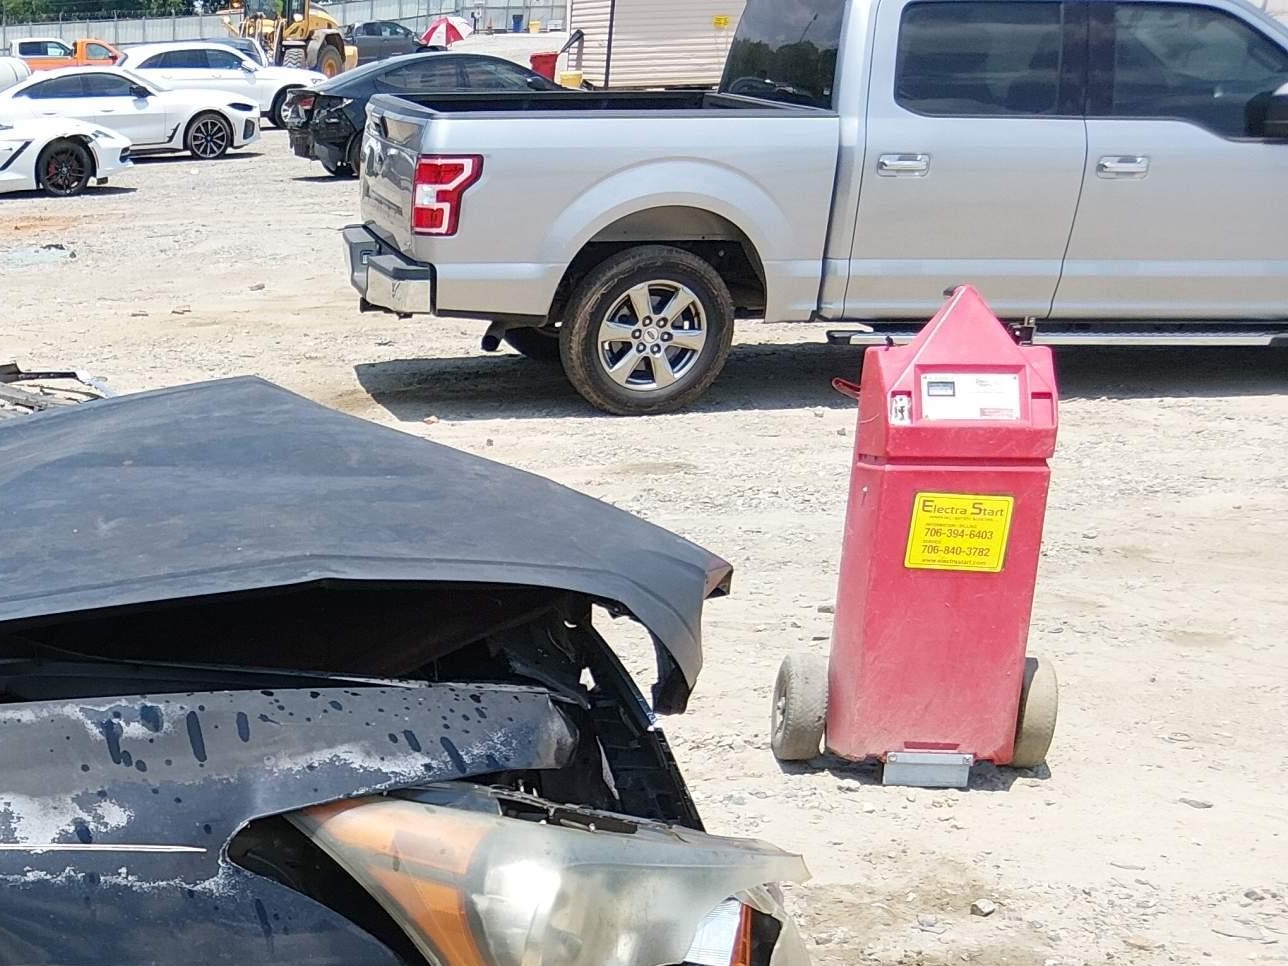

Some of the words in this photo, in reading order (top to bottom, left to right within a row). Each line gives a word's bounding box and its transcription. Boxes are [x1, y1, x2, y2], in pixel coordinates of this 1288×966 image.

[922, 499, 968, 515] Electra
[970, 502, 1004, 517] Start
[924, 527, 994, 540] 706-394-6403
[921, 544, 991, 557] 706-840-3782
